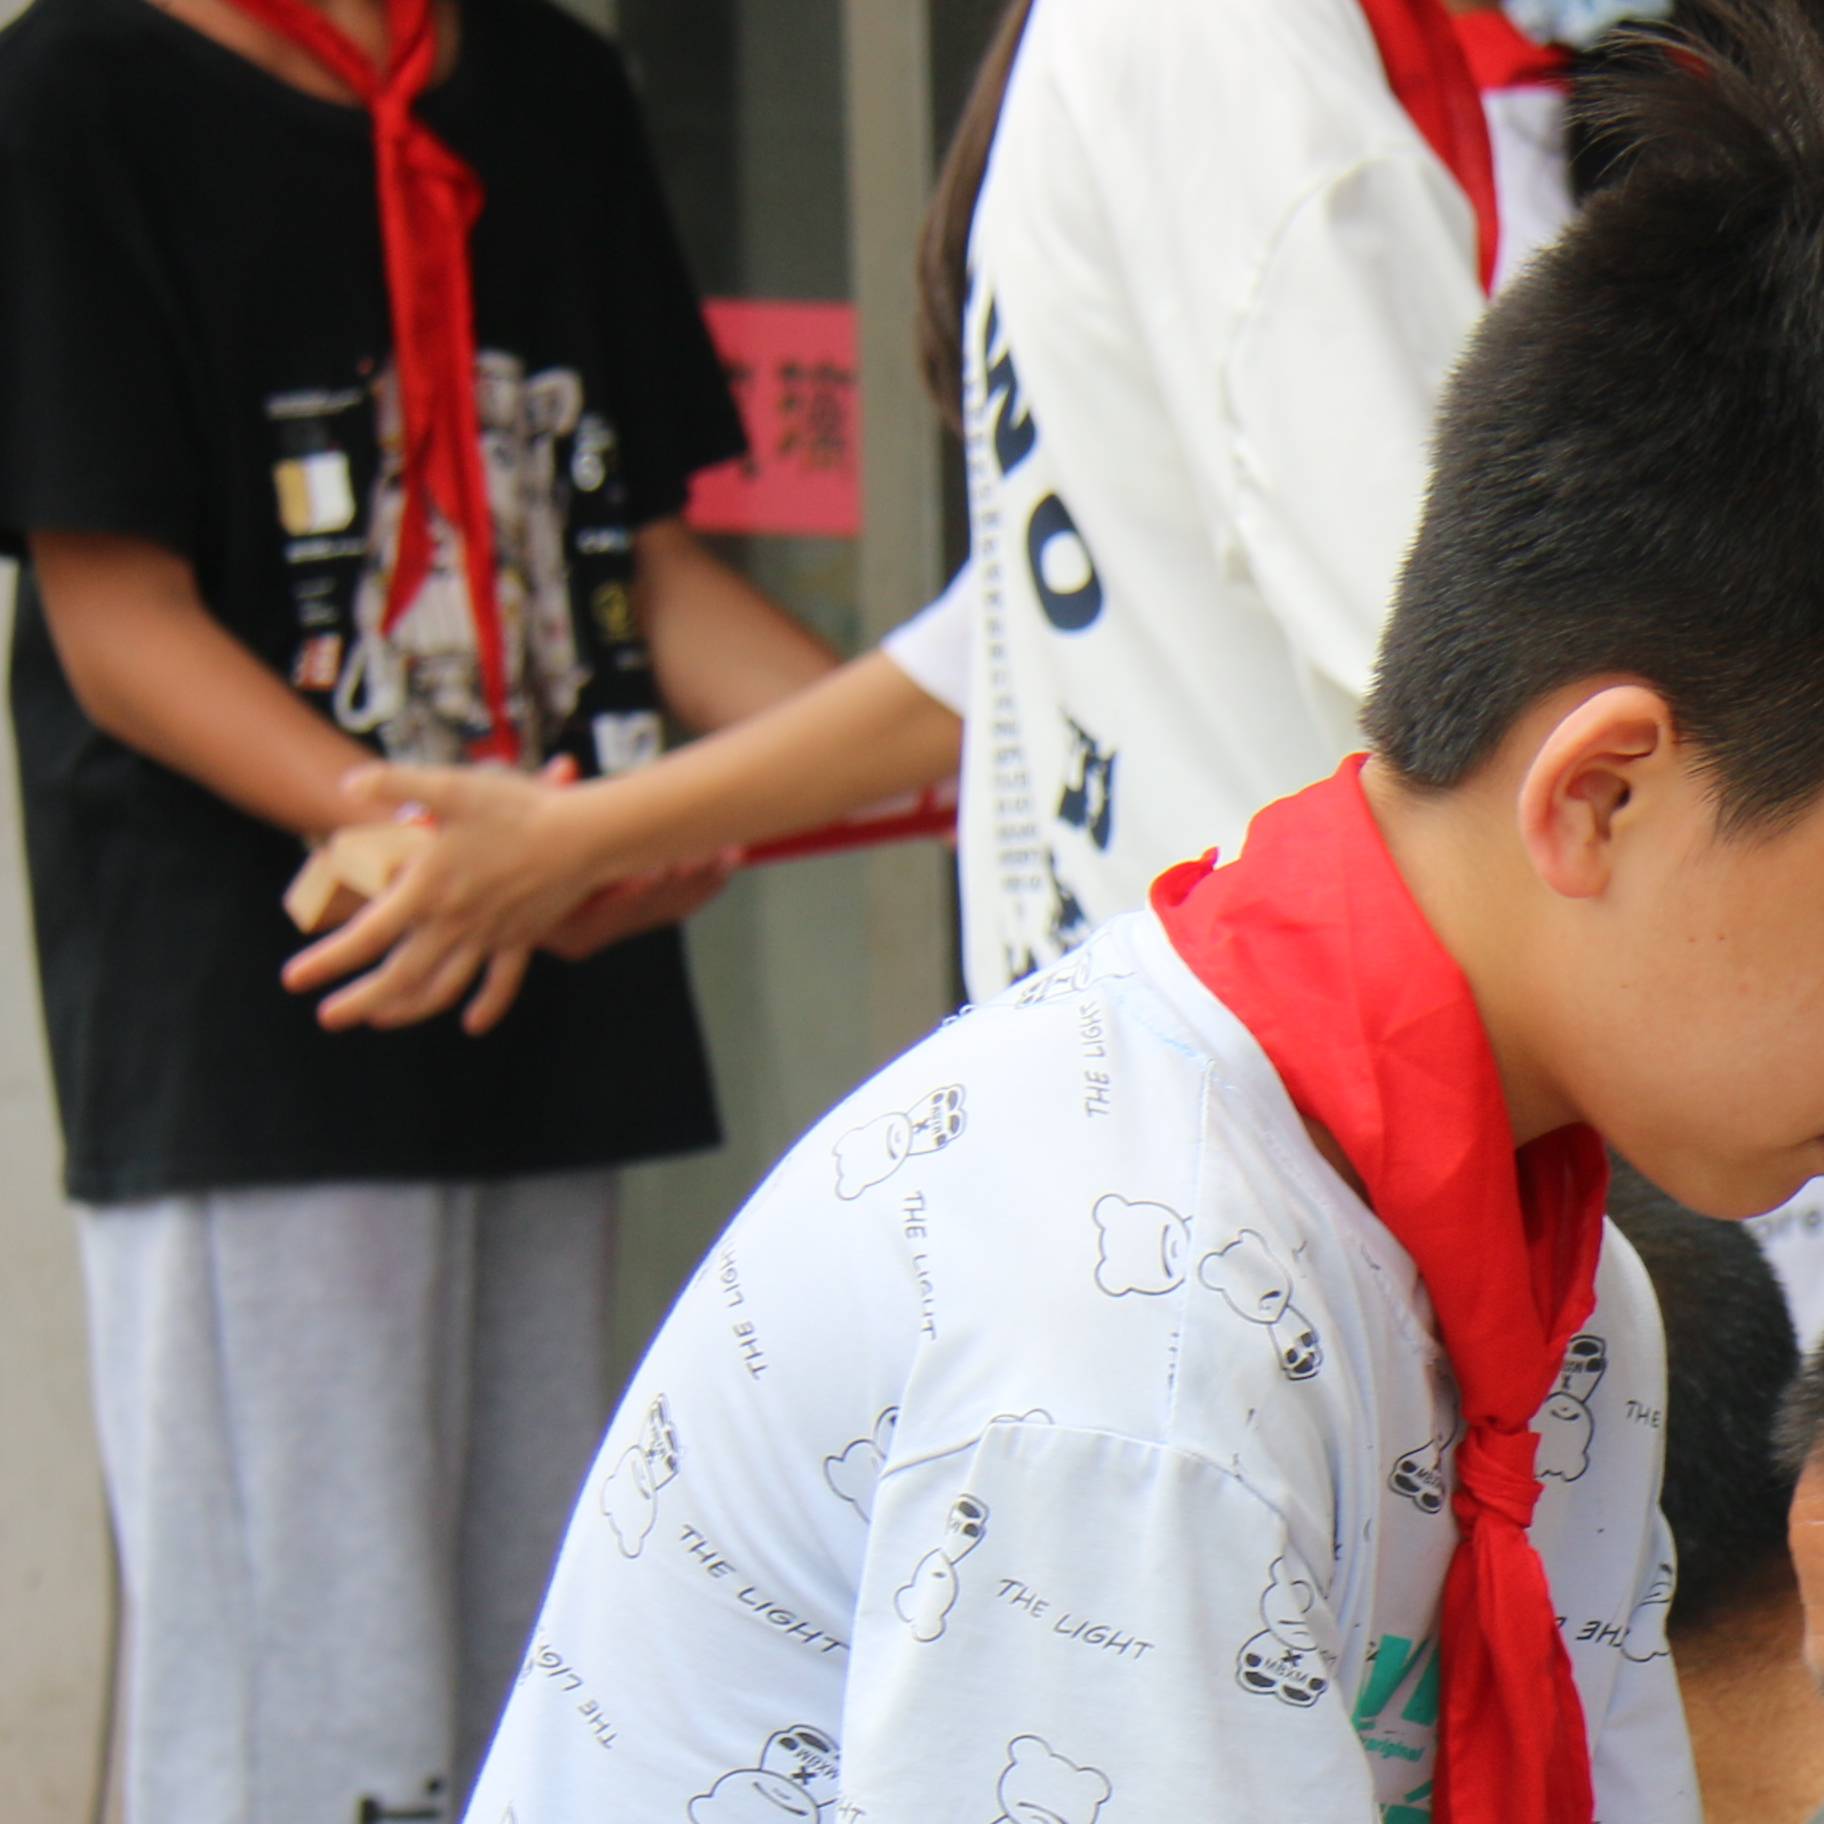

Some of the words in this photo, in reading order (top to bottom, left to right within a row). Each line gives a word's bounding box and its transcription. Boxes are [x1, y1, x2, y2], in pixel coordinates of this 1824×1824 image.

[903, 1190, 928, 1239] THE
[732, 1319, 769, 1381] THE
[1624, 1400, 1662, 1429] THE
[679, 1523, 737, 1579] THE
[736, 1586, 851, 1654] LIGHT
[996, 1578, 1051, 1619] THE
[1052, 1613, 1156, 1660] LIGHT
